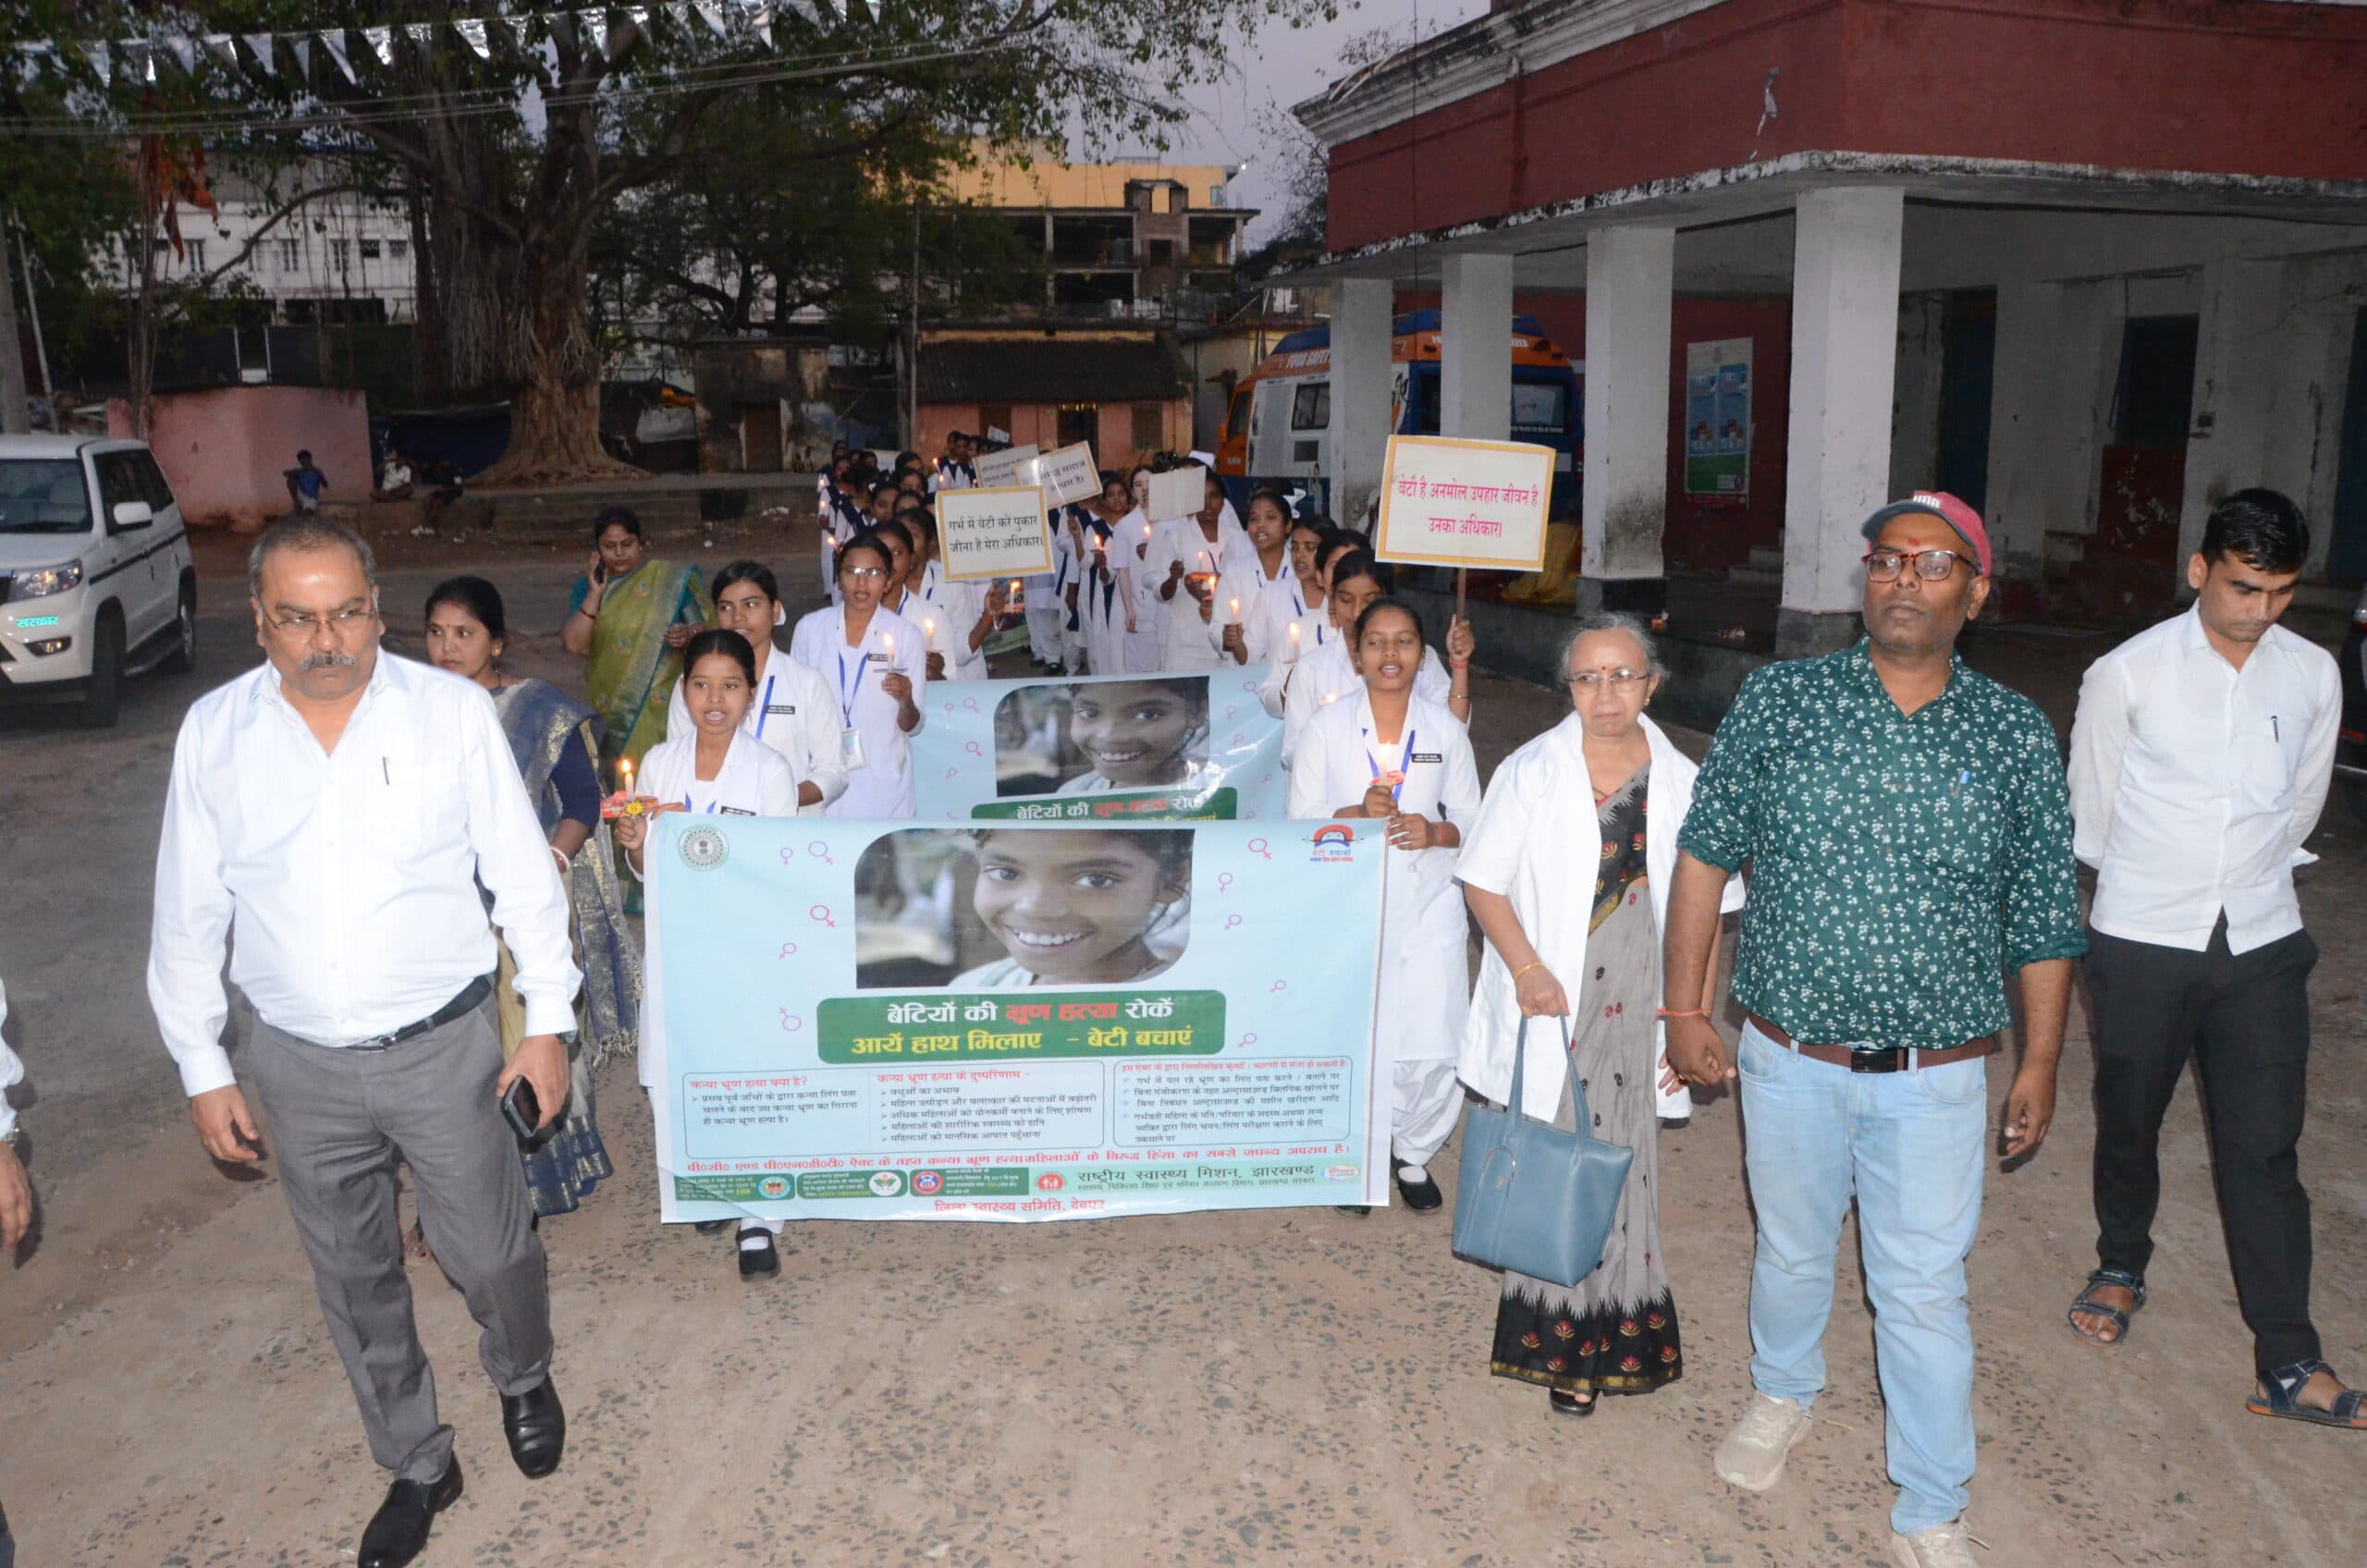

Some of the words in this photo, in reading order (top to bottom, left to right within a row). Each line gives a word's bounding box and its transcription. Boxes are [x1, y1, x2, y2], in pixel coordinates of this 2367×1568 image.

[1399, 474, 1417, 496] बेटी
[1430, 478, 1467, 500] अनमोल
[1471, 485, 1499, 503] उपहार
[1502, 484, 1528, 505] जीवन
[949, 516, 964, 532] गर्भ
[977, 515, 995, 528] बेटी
[1014, 516, 1037, 532] पुकार
[1429, 518, 1456, 533] उनका
[950, 539, 973, 554] जीना
[985, 536, 1000, 550] मेरा
[1017, 802, 1062, 820] बेटियों
[1067, 801, 1088, 816] की
[888, 1001, 956, 1024] बेटियों
[964, 1002, 998, 1022] की
[1059, 1002, 1117, 1021] हत्या
[1125, 997, 1173, 1018] रोकें
[852, 1029, 902, 1054] आयें
[912, 1033, 959, 1054] हाथ
[968, 1029, 1042, 1051] मिलाए
[1088, 1027, 1127, 1047] बेटी
[1136, 1024, 1192, 1046] बचाएं
[692, 1081, 717, 1089] कन्या
[878, 1074, 903, 1084] कन्या
[956, 1071, 966, 1081] के
[928, 1156, 960, 1165] कन्या
[1087, 1151, 1098, 1161] के
[1183, 1151, 1198, 1159] का
[1206, 1147, 1235, 1158] सबसे
[1078, 1169, 1125, 1183] राष्ट्रीय
[1136, 1169, 1187, 1181] स्वास्थ्य
[1252, 1165, 1315, 1177] झारखण्ड
